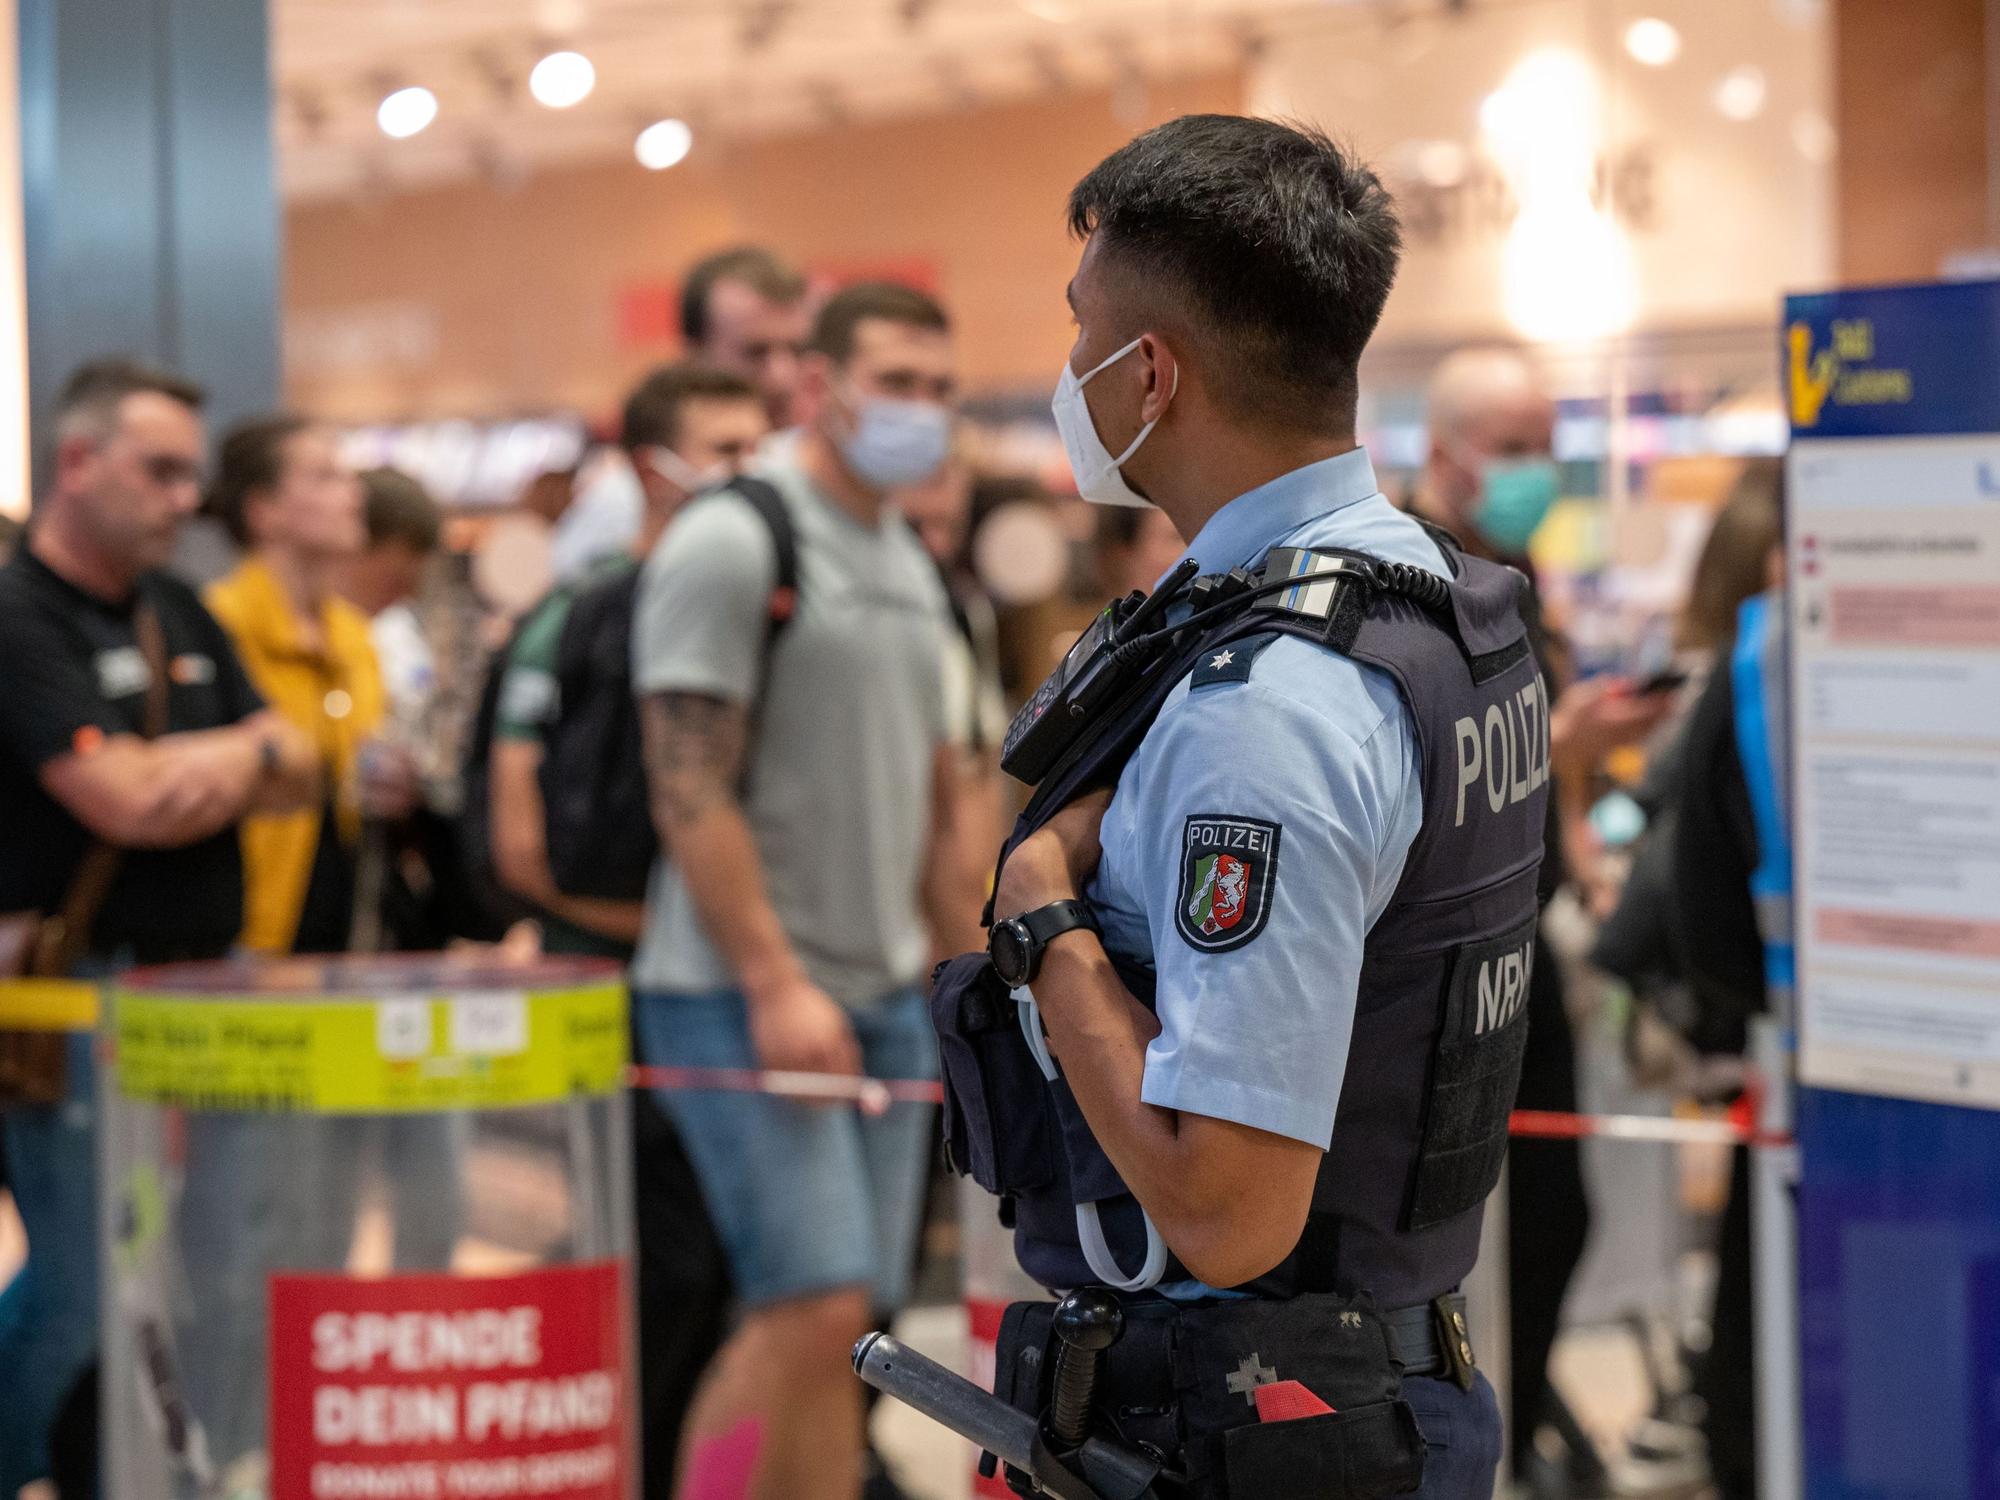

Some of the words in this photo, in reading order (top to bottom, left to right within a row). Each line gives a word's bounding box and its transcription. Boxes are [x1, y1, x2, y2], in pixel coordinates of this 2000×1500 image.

[1190, 827, 1268, 852] POLIZEI
[312, 1306, 541, 1373] SPENDE
[312, 1382, 457, 1445] DEIN
[466, 1371, 614, 1441] PFAND
